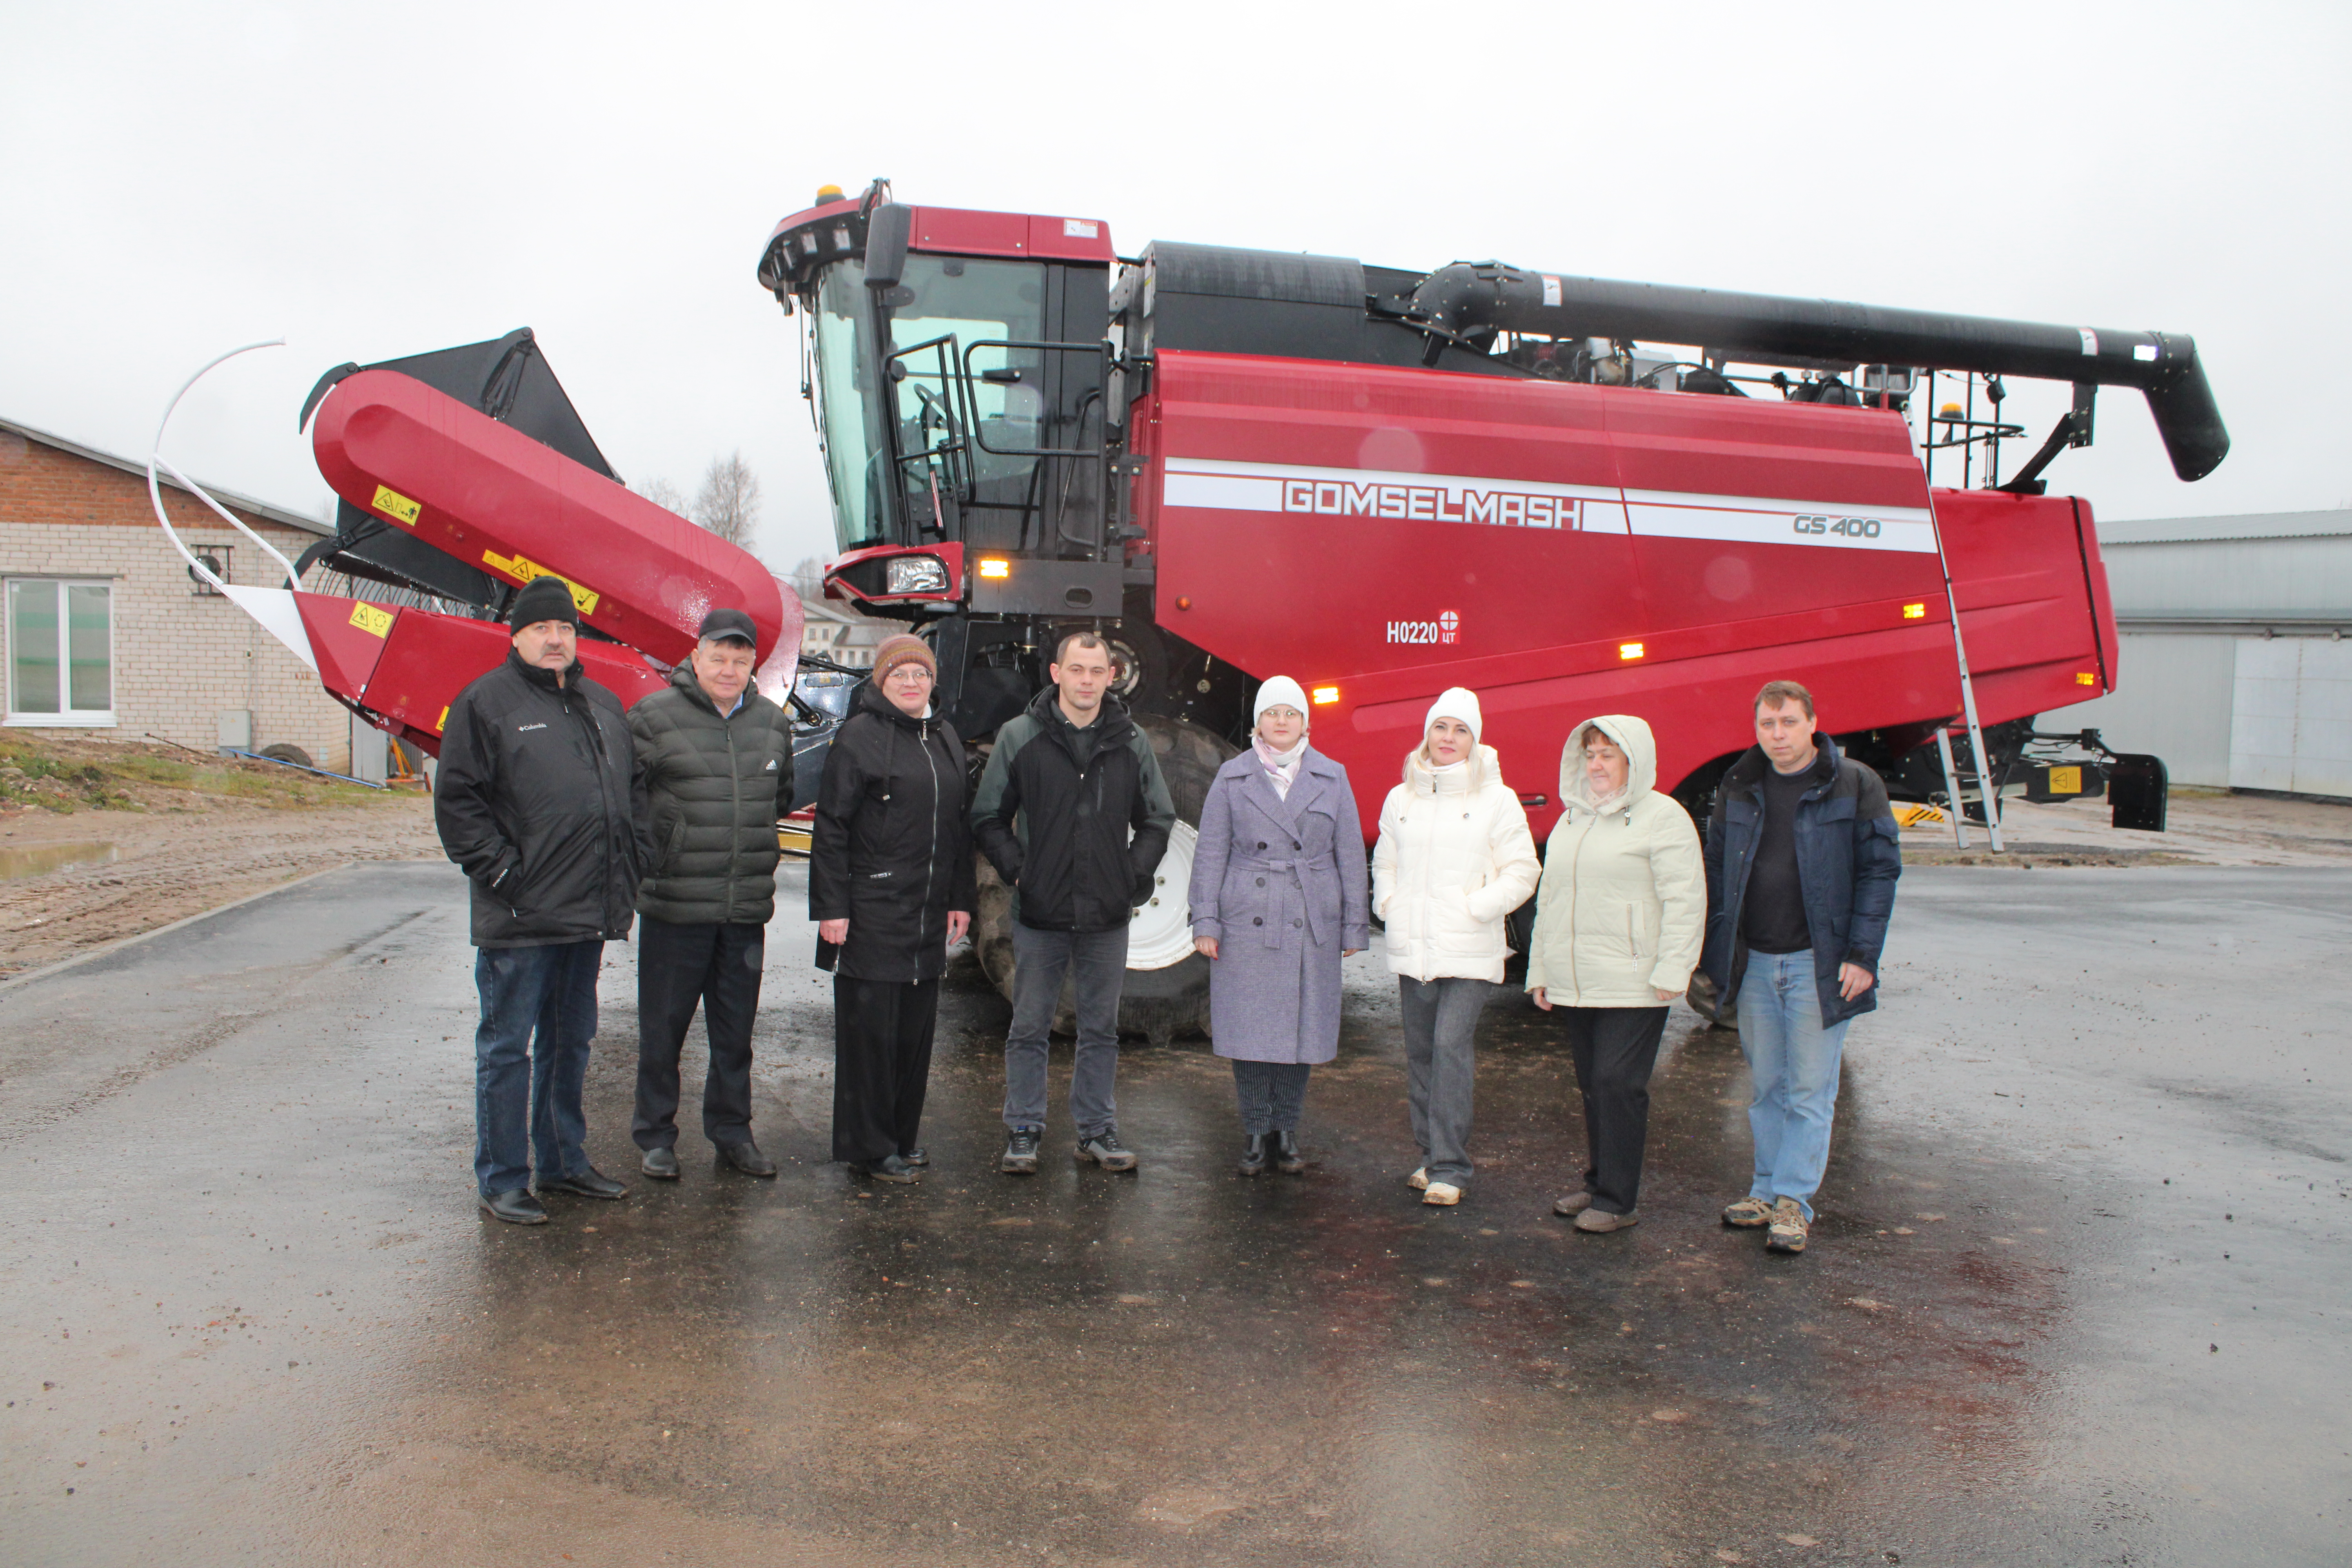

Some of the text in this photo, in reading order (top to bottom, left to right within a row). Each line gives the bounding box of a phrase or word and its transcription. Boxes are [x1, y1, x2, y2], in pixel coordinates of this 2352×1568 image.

[1285, 480, 1581, 531] GOMSELMASH
[1793, 515, 1881, 538] GS 400
[1442, 632, 1456, 644] ЦТ
